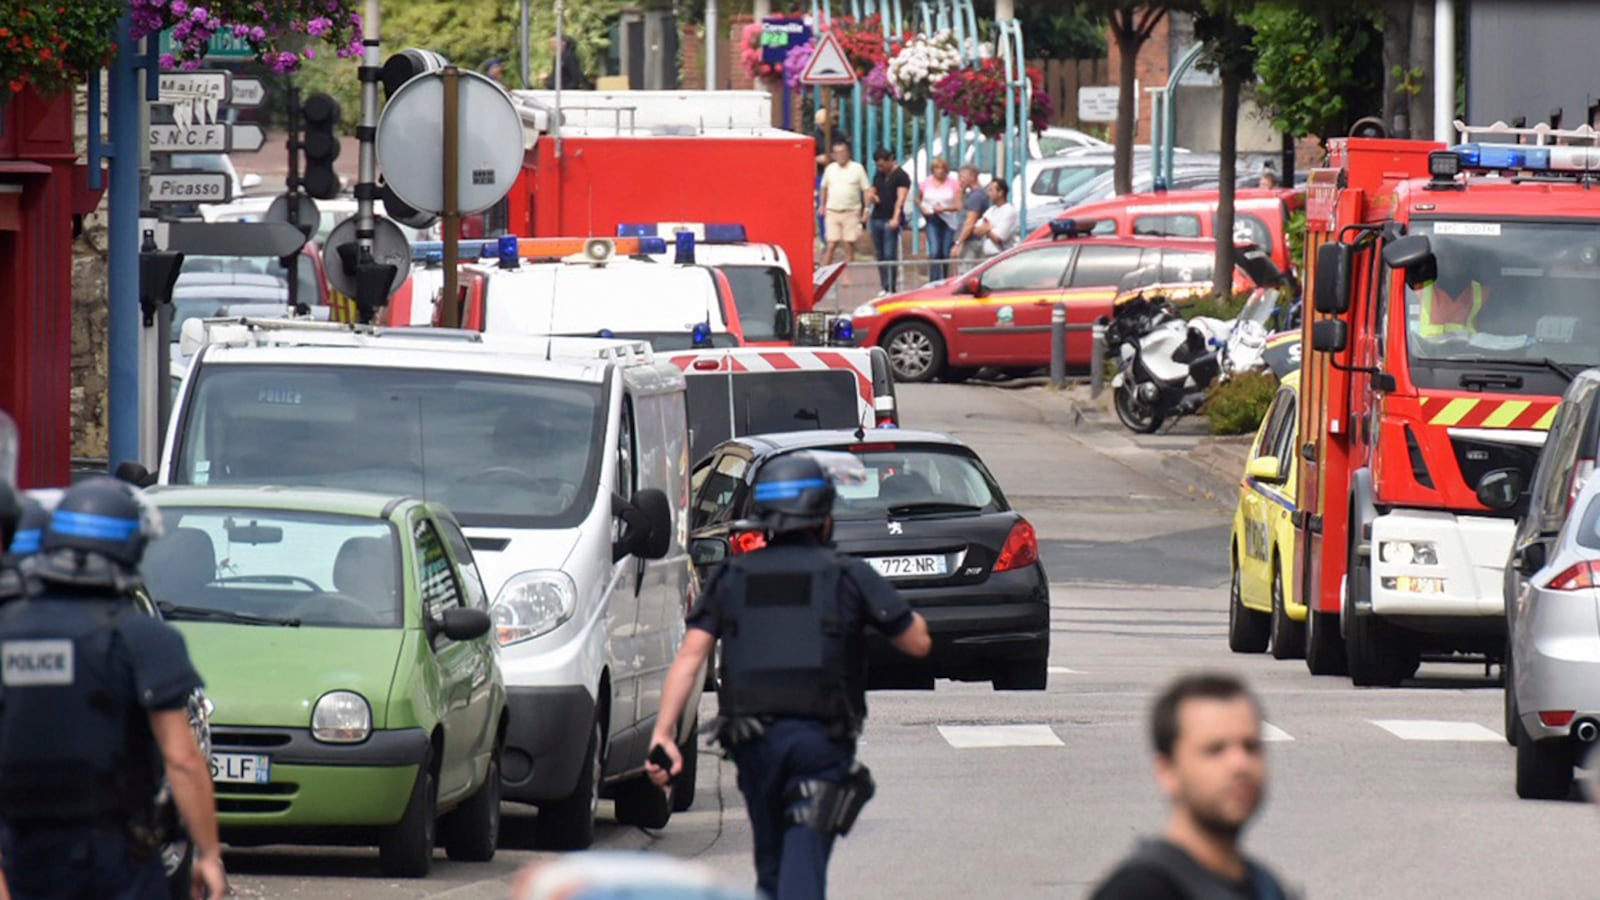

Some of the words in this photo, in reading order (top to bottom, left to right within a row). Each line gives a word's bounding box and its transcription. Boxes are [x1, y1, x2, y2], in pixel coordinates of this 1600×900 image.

[160, 180, 220, 195] Picasso
[258, 389, 302, 404] POLICE
[7, 653, 66, 672] POLICE
